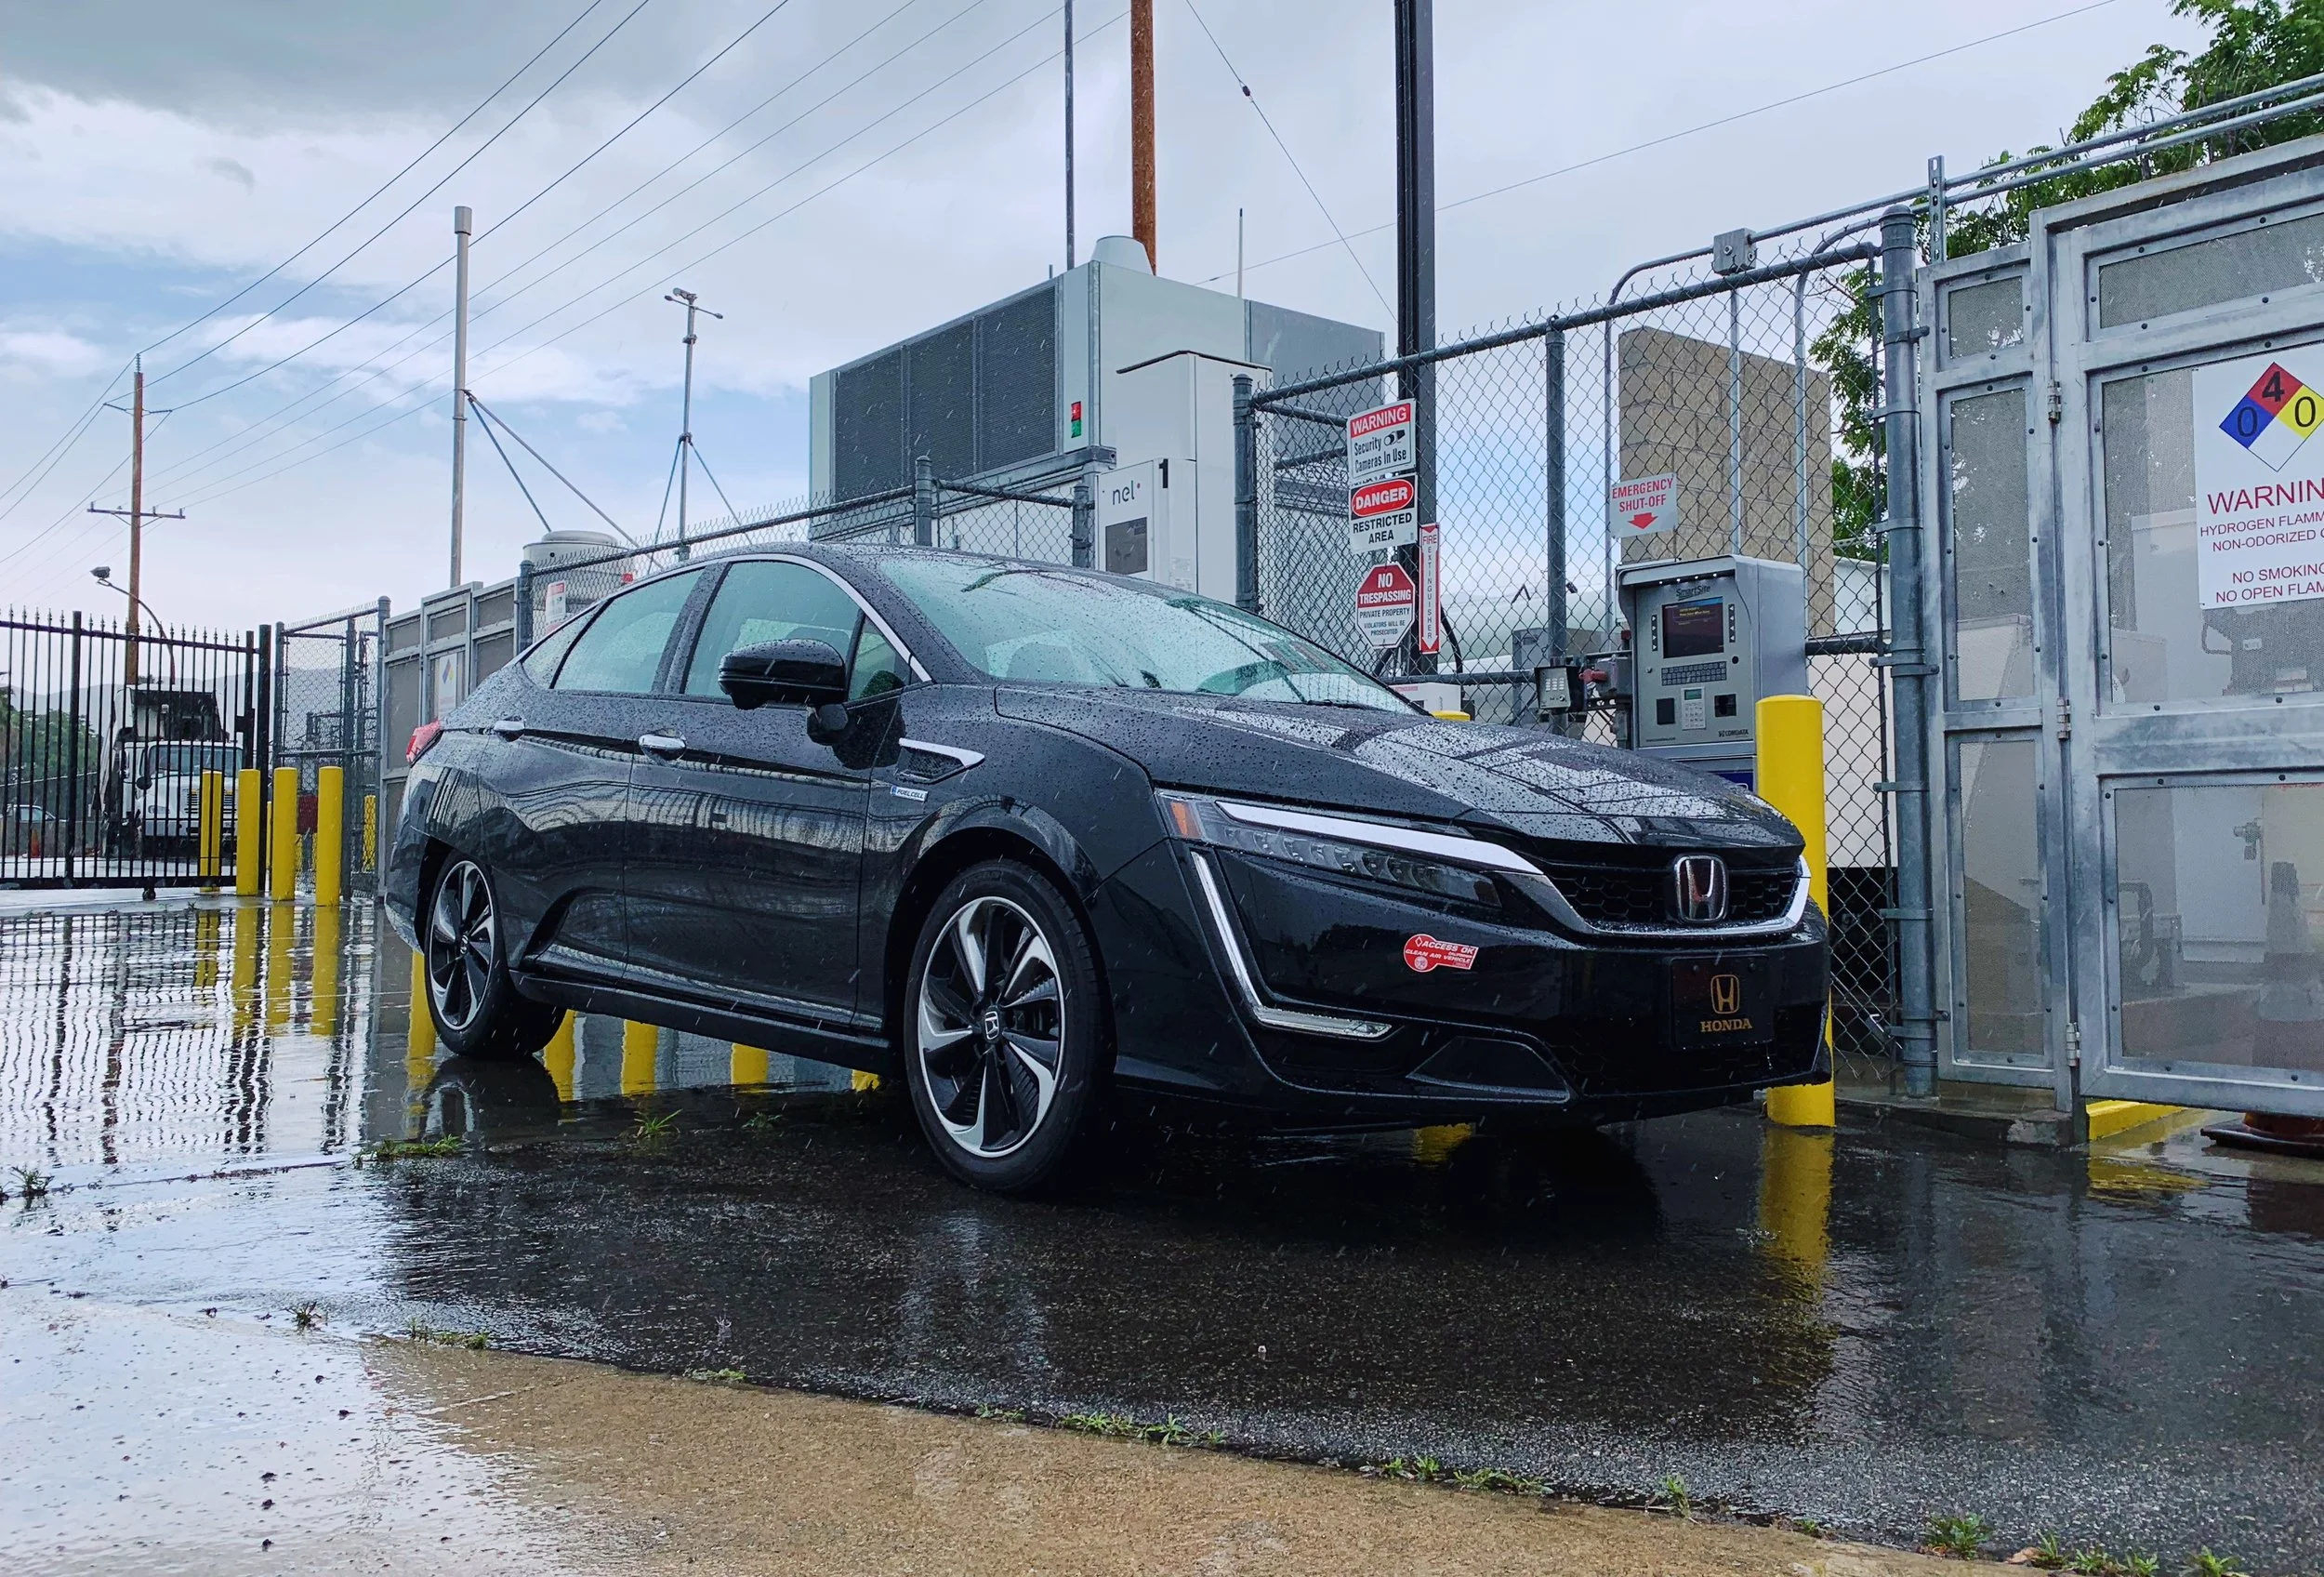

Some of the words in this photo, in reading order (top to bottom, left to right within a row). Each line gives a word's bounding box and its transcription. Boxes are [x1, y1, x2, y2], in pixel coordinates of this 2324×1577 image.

[2262, 371, 2285, 403] 4
[1352, 406, 1406, 436] WARNING
[2237, 406, 2258, 438] 0
[2294, 396, 2317, 428] 0
[1353, 436, 1382, 456] Security
[1354, 456, 1382, 473] Cameras
[1383, 450, 1391, 465] In
[1393, 448, 1406, 462] Use
[1158, 458, 1169, 488] 1
[1112, 479, 1135, 506] nel
[1355, 486, 1408, 510] DANGER
[1612, 477, 1673, 499] EMERGENCY
[2207, 477, 2324, 515] WARNIN
[1618, 494, 1667, 513] SHUT-OFF
[1353, 512, 1412, 534] RESTRICTED
[2199, 517, 2275, 537] HYDROGEN
[1368, 529, 1394, 545] AREA
[1422, 534, 1437, 545] FIRE
[2212, 529, 2317, 552] NON-ODORIZED
[1378, 572, 1393, 589] NO
[2232, 570, 2254, 585] NO
[1359, 589, 1412, 604] TRESPASSING
[2215, 590, 2238, 603] NO
[2241, 585, 2283, 601] OPEN
[1359, 609, 1380, 619] PRIVATE
[1381, 607, 1410, 617] PROPERTY
[897, 788, 910, 797] FUEL
[1405, 948, 1429, 957] CLEAN
[1443, 955, 1471, 963] VEHICLE
[1421, 940, 1459, 951] ACCESS
[1460, 947, 1475, 955] OK
[1700, 1018, 1753, 1033] HONDA
